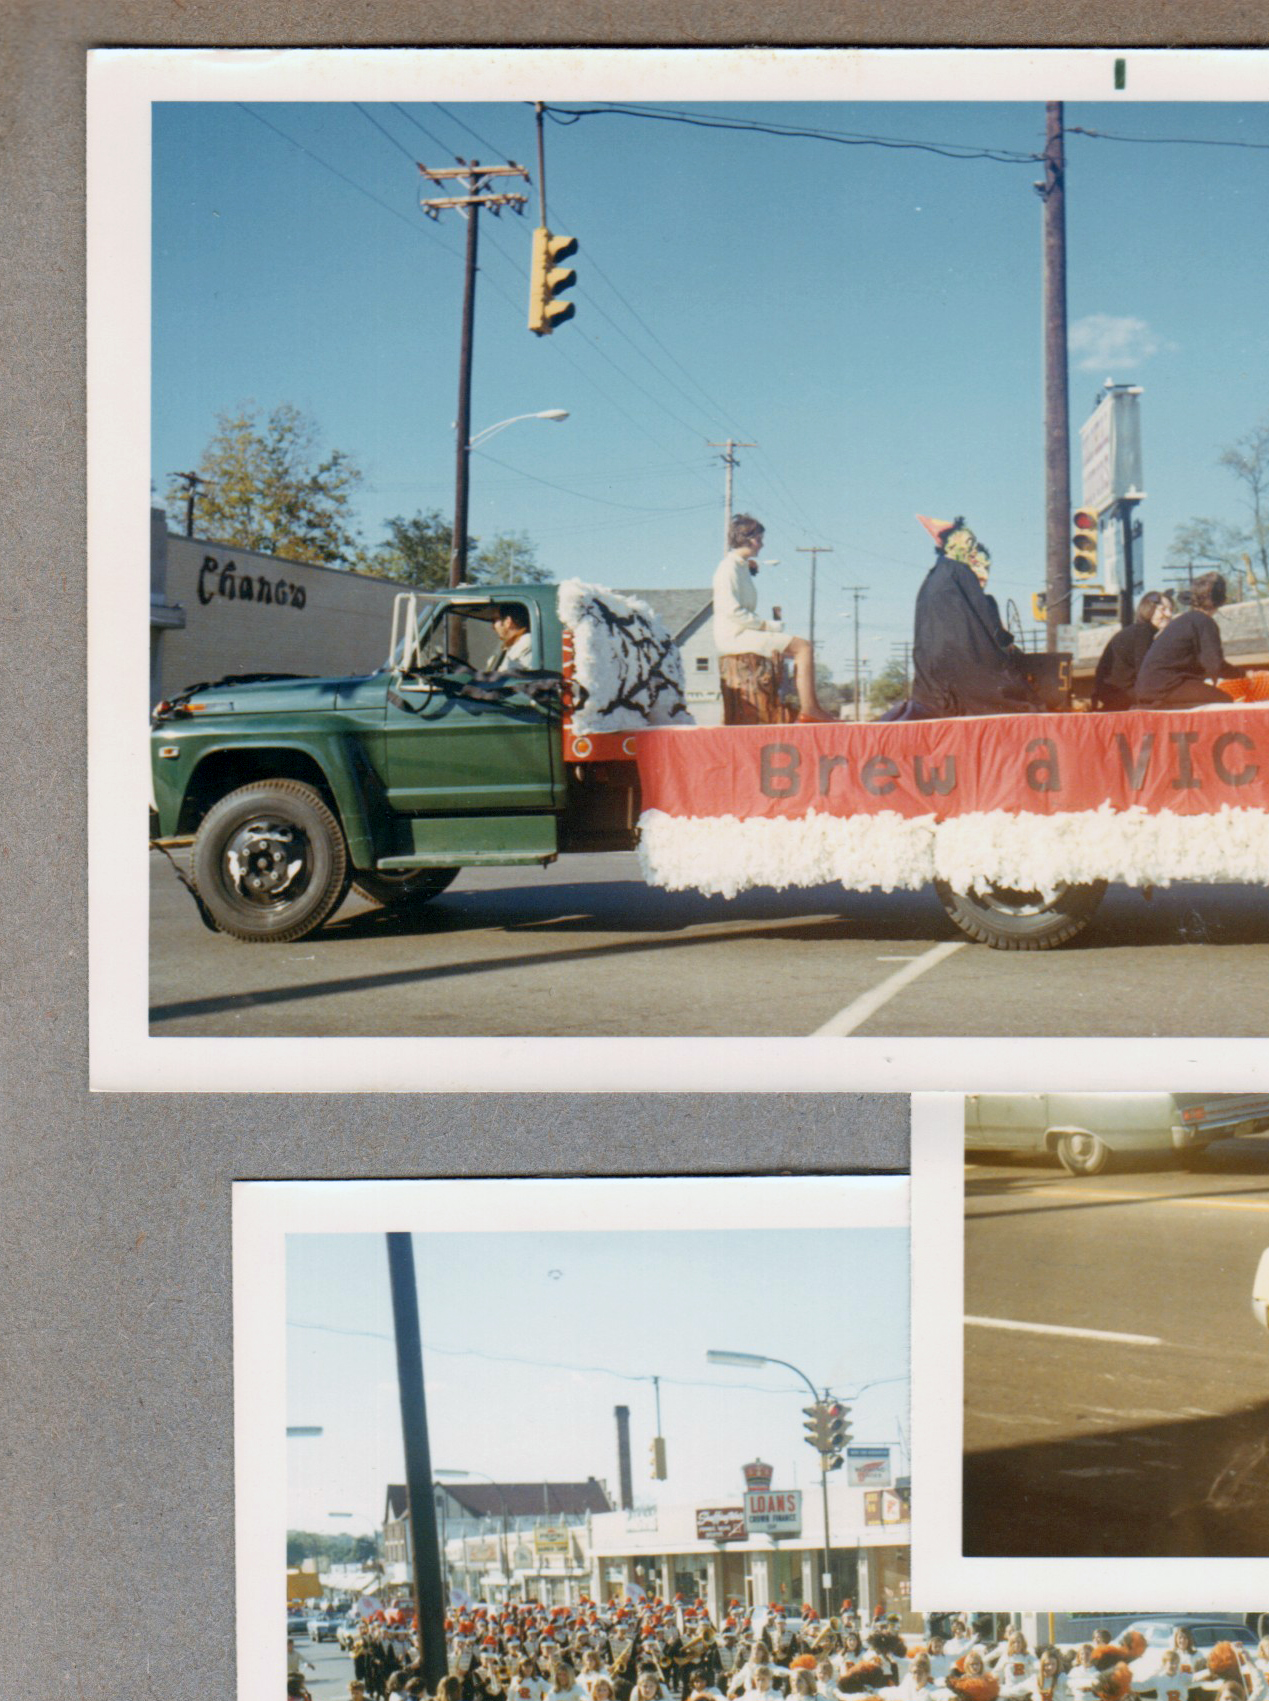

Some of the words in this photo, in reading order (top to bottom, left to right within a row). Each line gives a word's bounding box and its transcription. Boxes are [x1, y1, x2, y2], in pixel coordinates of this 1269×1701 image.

[760, 743, 957, 798] Brew
[1025, 737, 1062, 793] a
[749, 1494, 797, 1514] LOANS
